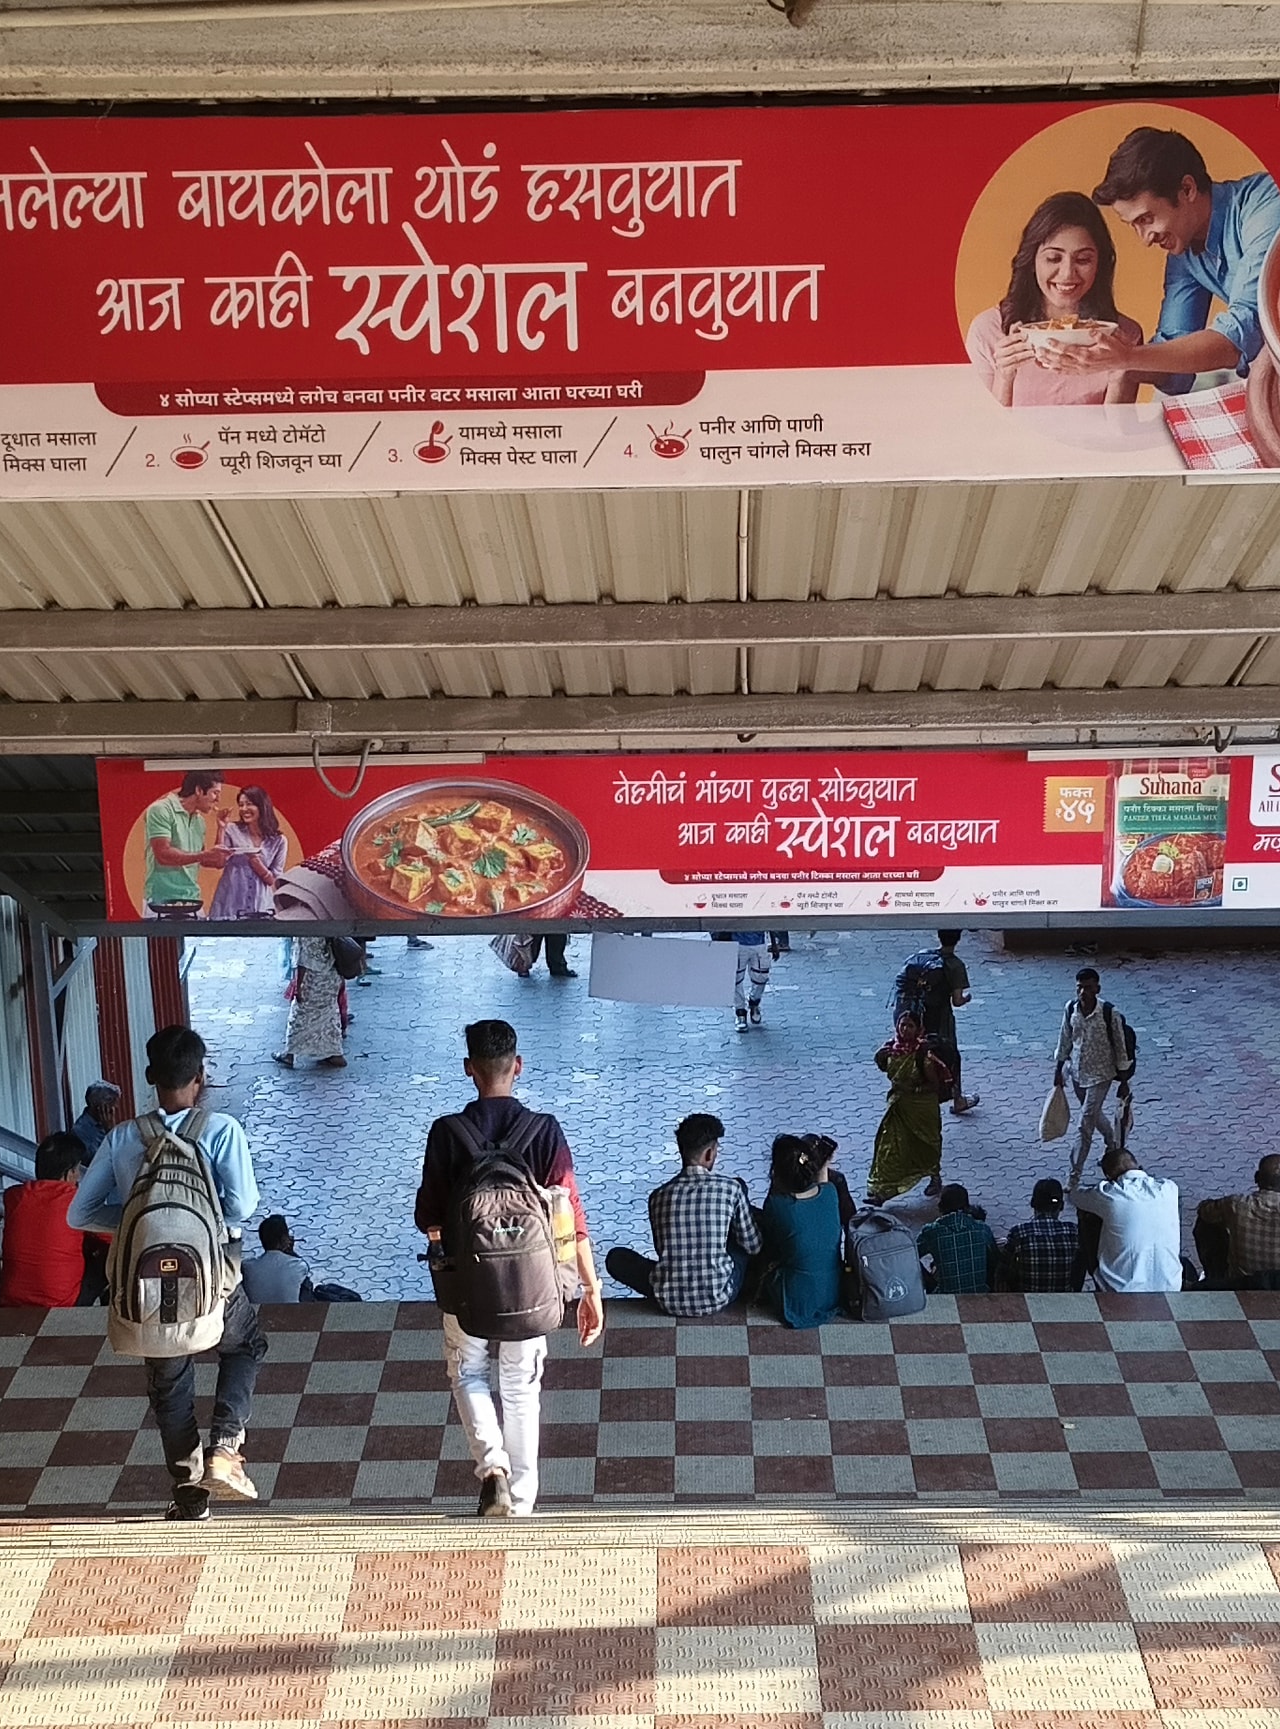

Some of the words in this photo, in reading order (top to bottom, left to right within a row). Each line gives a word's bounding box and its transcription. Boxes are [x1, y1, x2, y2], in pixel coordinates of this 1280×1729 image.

[172, 141, 394, 227] बायकोला
[415, 138, 500, 224] थोडं
[96, 277, 185, 335] आज
[204, 250, 313, 330] काही
[328, 221, 588, 355] स्पेशल
[175, 388, 219, 408] सोप्या
[300, 387, 338, 405] लगेच
[343, 388, 384, 405] बनवा
[389, 385, 426, 404] पनीर
[430, 388, 461, 403] बटर
[466, 386, 517, 402] मसाला
[522, 386, 560, 401] आता
[565, 385, 612, 401] घरच्या
[617, 381, 643, 400] घरी
[219, 426, 241, 444] पॅन
[246, 425, 279, 444] मध्ये
[283, 423, 326, 443] टोमॅटो
[459, 422, 507, 441] यामध्ये
[512, 423, 562, 440] मसाला
[699, 415, 735, 436] पनीर
[740, 414, 781, 434] आणि
[786, 413, 823, 433] पाणी
[0, 431, 40, 452] दूधात
[47, 431, 97, 447] मसाला
[747, 439, 789, 460] चांगले
[795, 440, 836, 459] मिक्स
[842, 441, 871, 458] करा
[3, 454, 45, 473] मिक्स
[51, 456, 87, 472] घाला
[220, 449, 252, 475] प्यूरी
[256, 447, 312, 472] शिजवून
[318, 452, 342, 469] घ्या
[460, 447, 502, 467] मिक्स
[507, 445, 536, 465] पेस्ट
[541, 447, 577, 464] घाला
[695, 770, 753, 804] भांडण
[1059, 787, 1094, 798] फक्त
[1140, 776, 1202, 795] Suhana
[1258, 800, 1273, 812] All
[678, 822, 717, 846] आज
[724, 812, 771, 845] काही
[775, 797, 901, 859] स्पेशल
